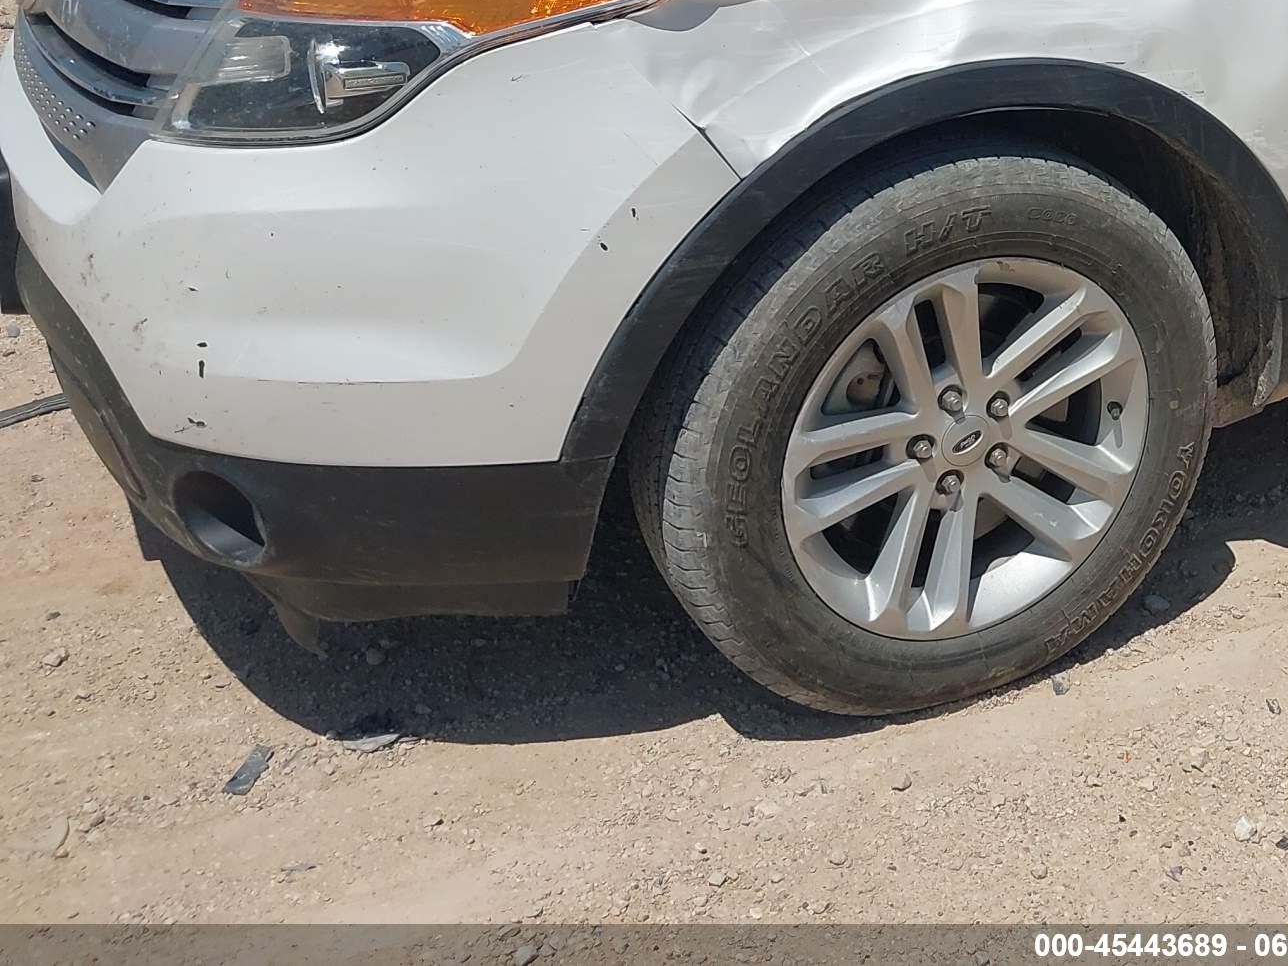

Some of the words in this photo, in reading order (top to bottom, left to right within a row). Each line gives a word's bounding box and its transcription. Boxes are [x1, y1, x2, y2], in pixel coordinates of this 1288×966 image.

[724, 250, 888, 549] GEOLANDAR
[903, 205, 993, 255] H/T
[1042, 441, 1195, 653] YOKOHAMA
